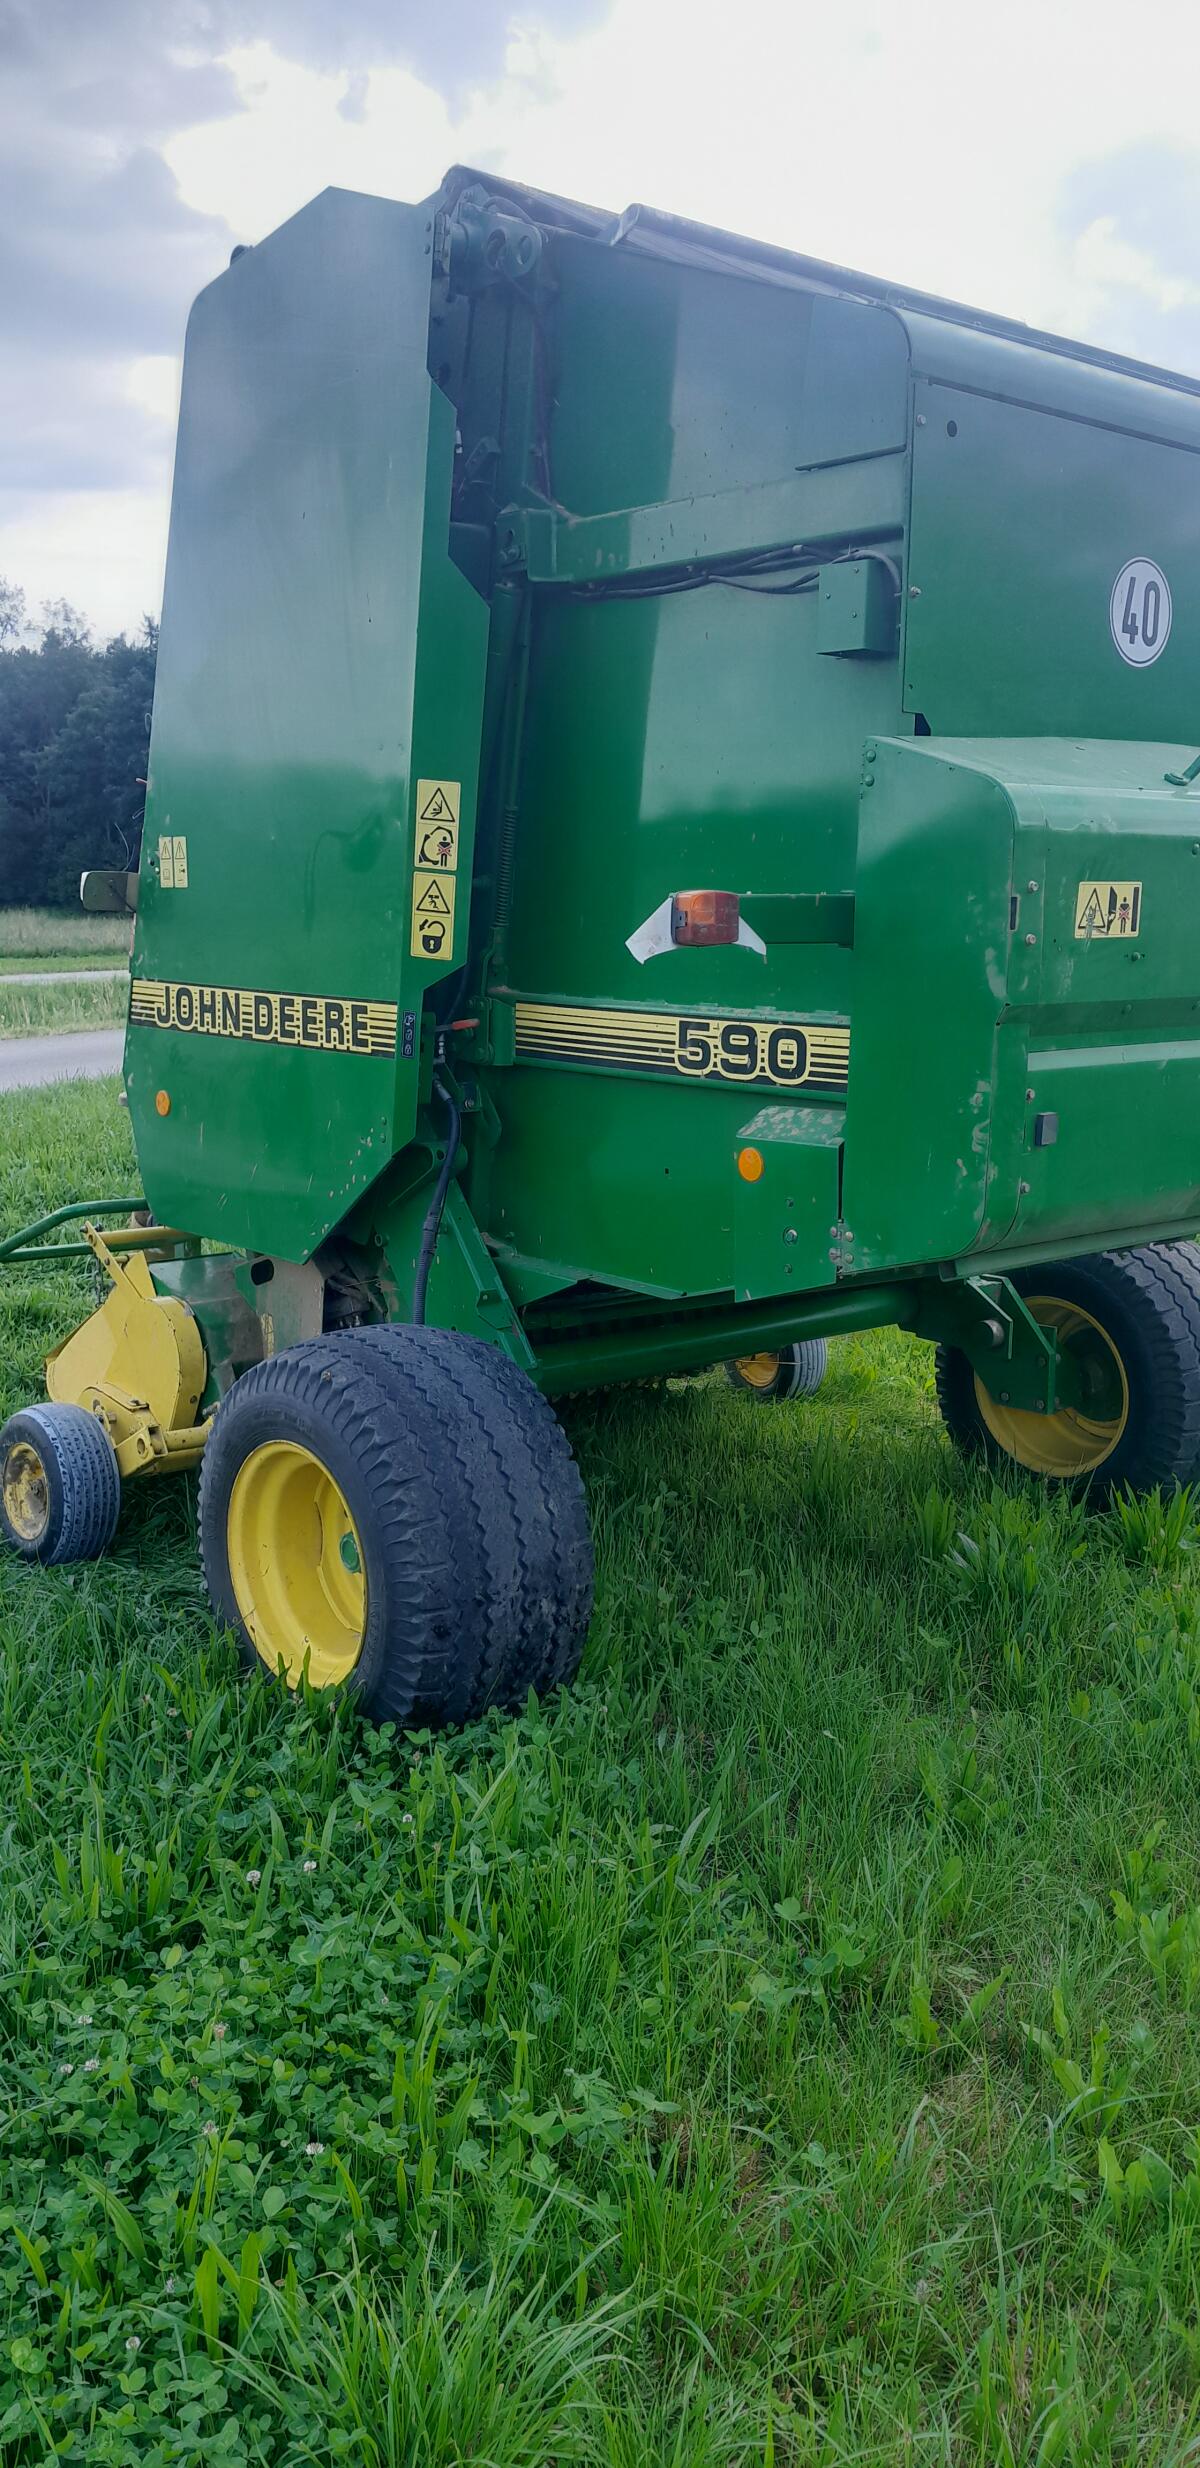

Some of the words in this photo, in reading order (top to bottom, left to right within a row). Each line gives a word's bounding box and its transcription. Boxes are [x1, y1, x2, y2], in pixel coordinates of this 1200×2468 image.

[1122, 576, 1161, 647] 40
[155, 985, 241, 1034] JOHN
[253, 995, 370, 1050] DEERE
[678, 1020, 808, 1081] 590
